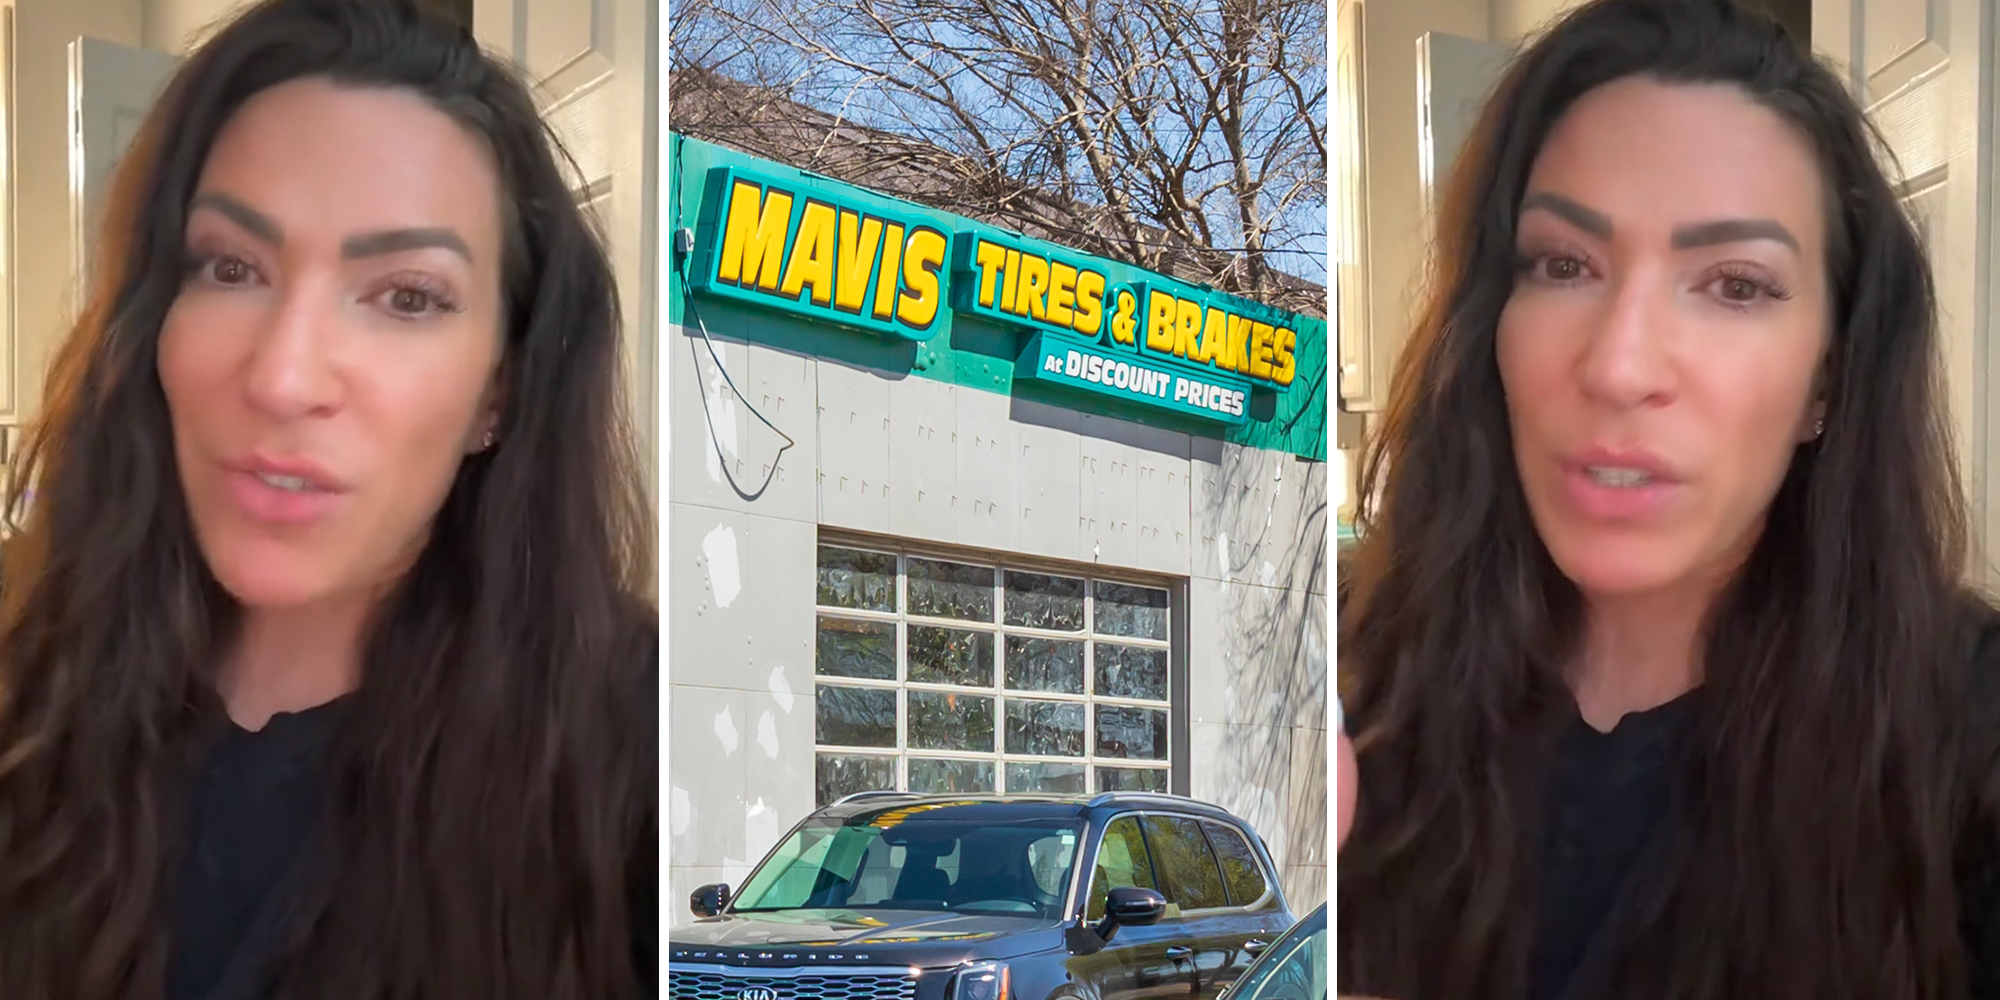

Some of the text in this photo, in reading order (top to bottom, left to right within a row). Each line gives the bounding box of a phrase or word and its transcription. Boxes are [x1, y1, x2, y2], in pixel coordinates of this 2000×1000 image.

[718, 180, 1297, 385] MAVIS TIRES & BRAKES
[1044, 350, 1245, 416] At DISCOUNT PRICES
[743, 989, 769, 1000] KIA
